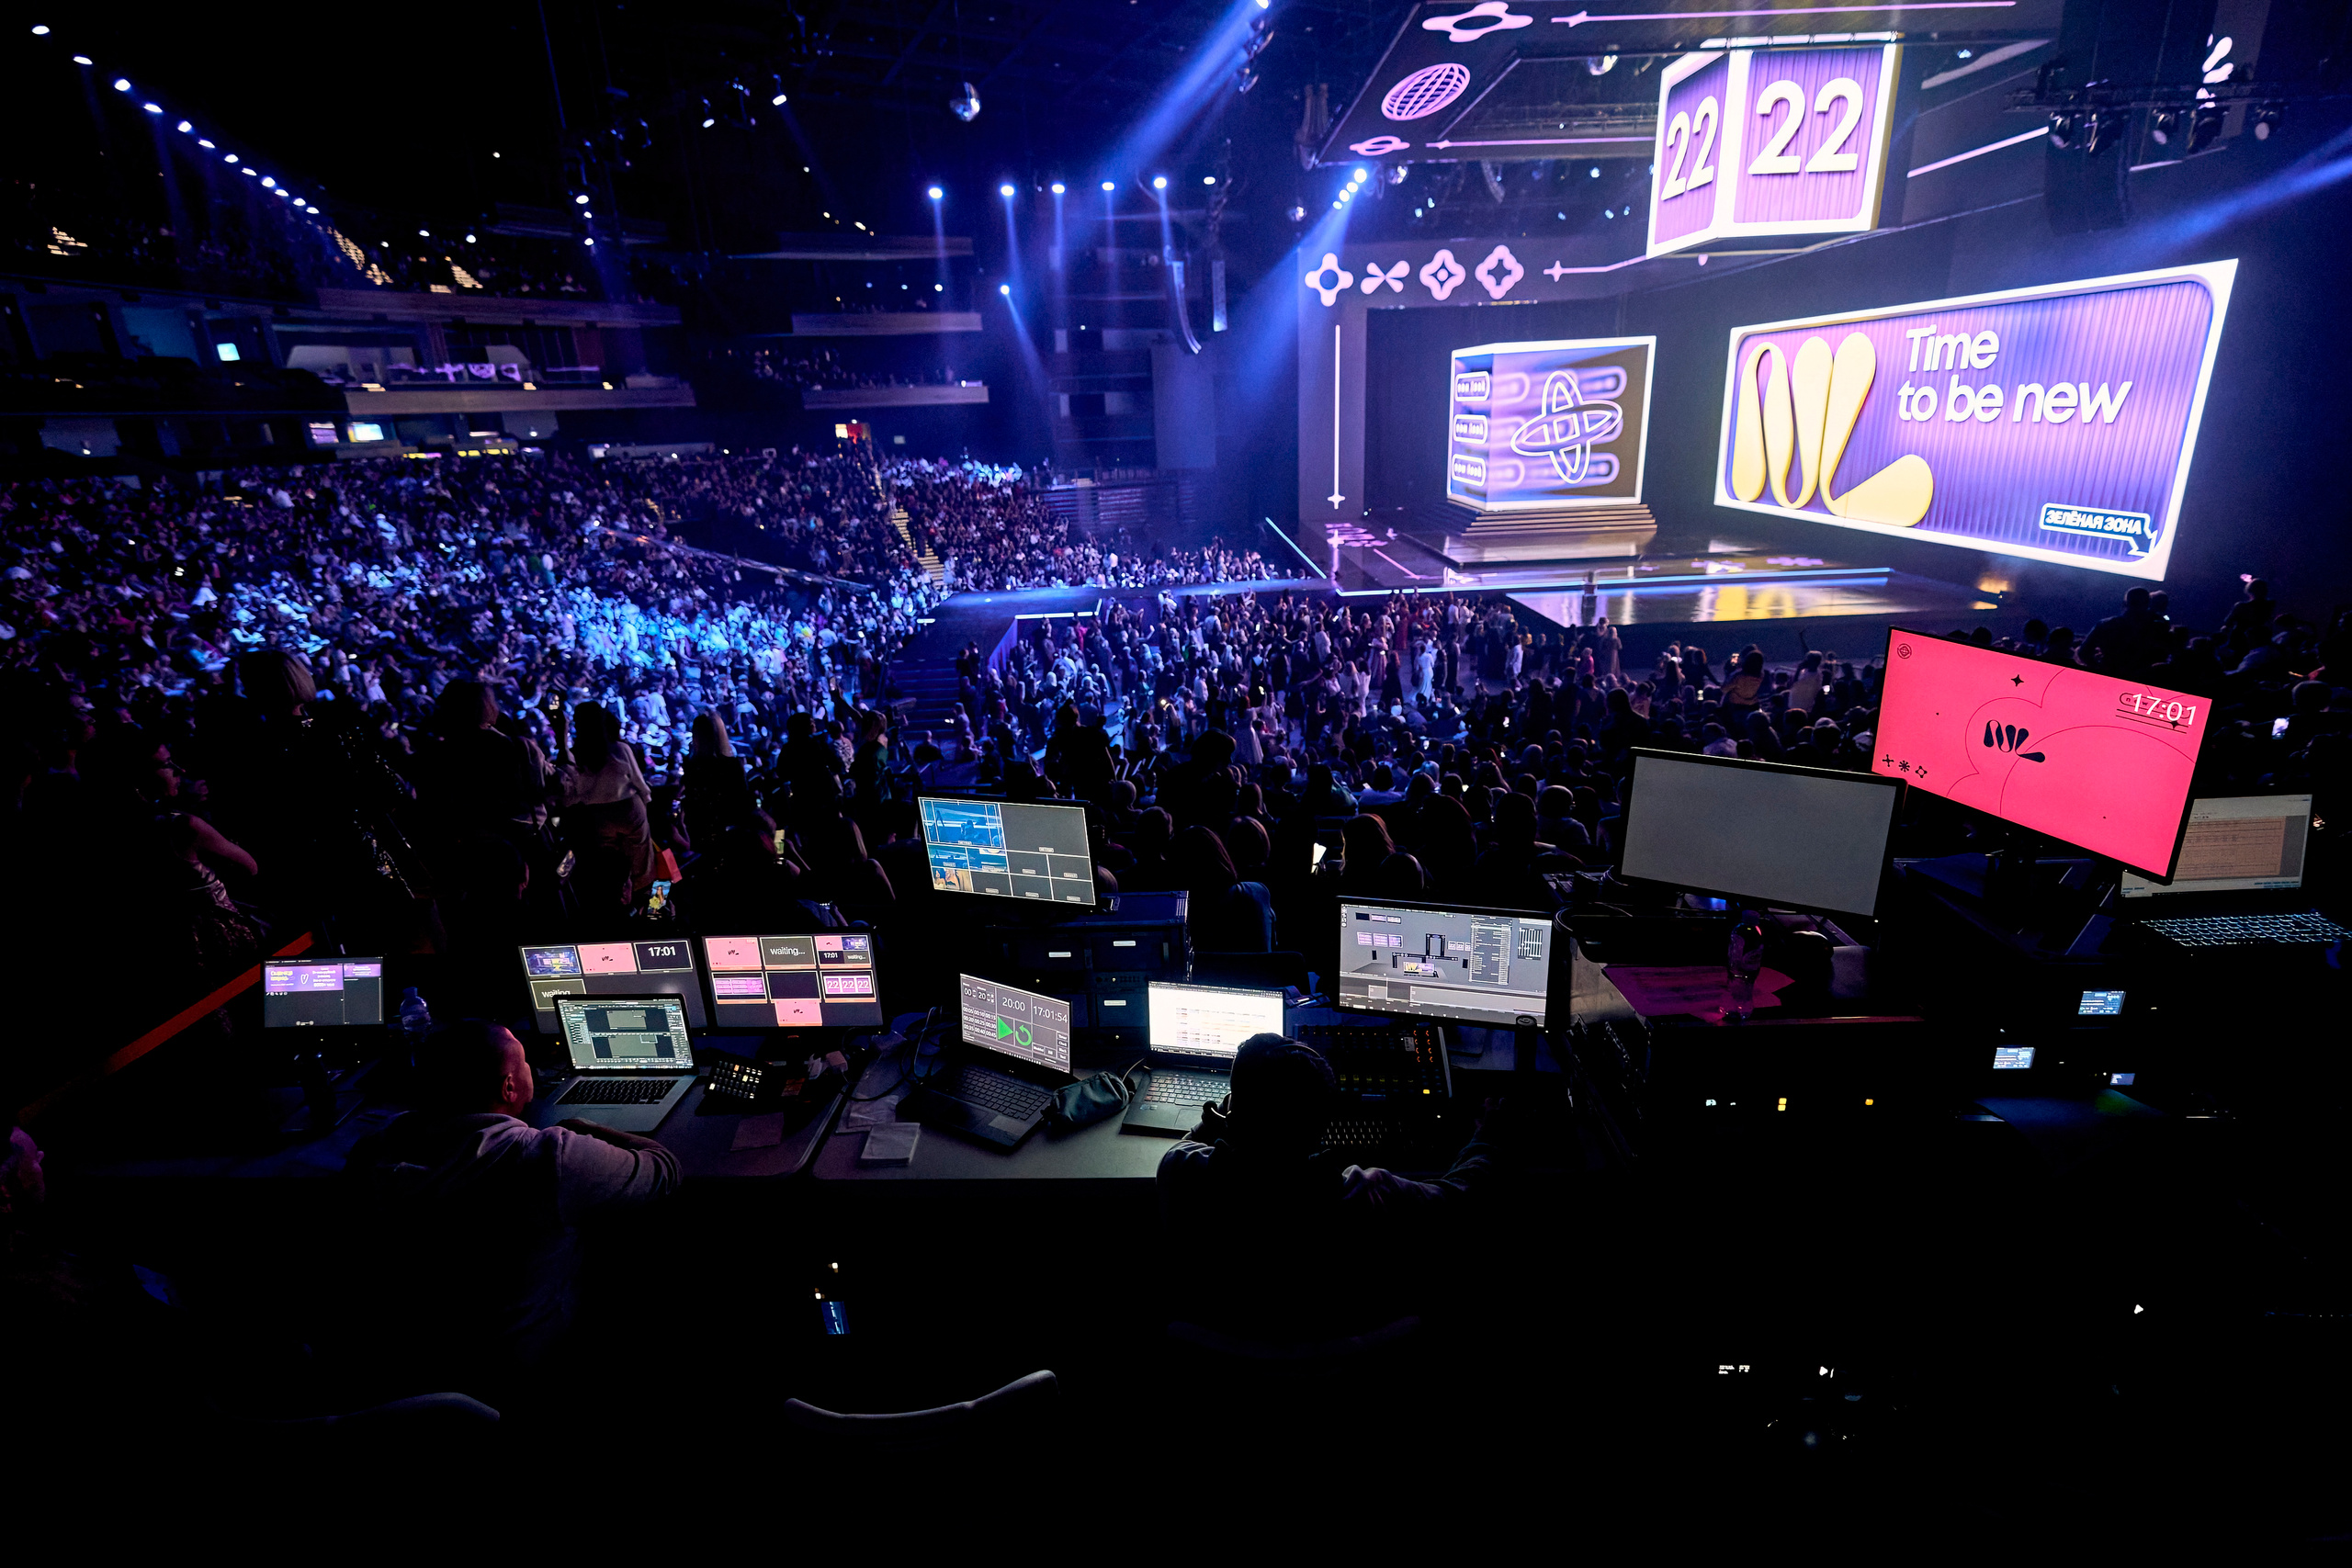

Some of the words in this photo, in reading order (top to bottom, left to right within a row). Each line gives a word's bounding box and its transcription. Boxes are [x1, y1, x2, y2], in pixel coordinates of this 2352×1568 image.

[1747, 77, 1864, 175] 22
[1661, 96, 1719, 201] 22
[1905, 324, 2000, 372] Time
[1897, 379, 1939, 422] to
[1945, 374, 2005, 423] be
[2012, 381, 2133, 424] new
[2045, 510, 2105, 530] ЗЕЛЁНАЯ
[2103, 516, 2143, 535] ЗОНА
[2132, 694, 2197, 725] 17:01
[648, 946, 676, 957] 17:01
[1002, 997, 1025, 1011] 20:00
[1034, 1006, 1068, 1022] 17:01:54
